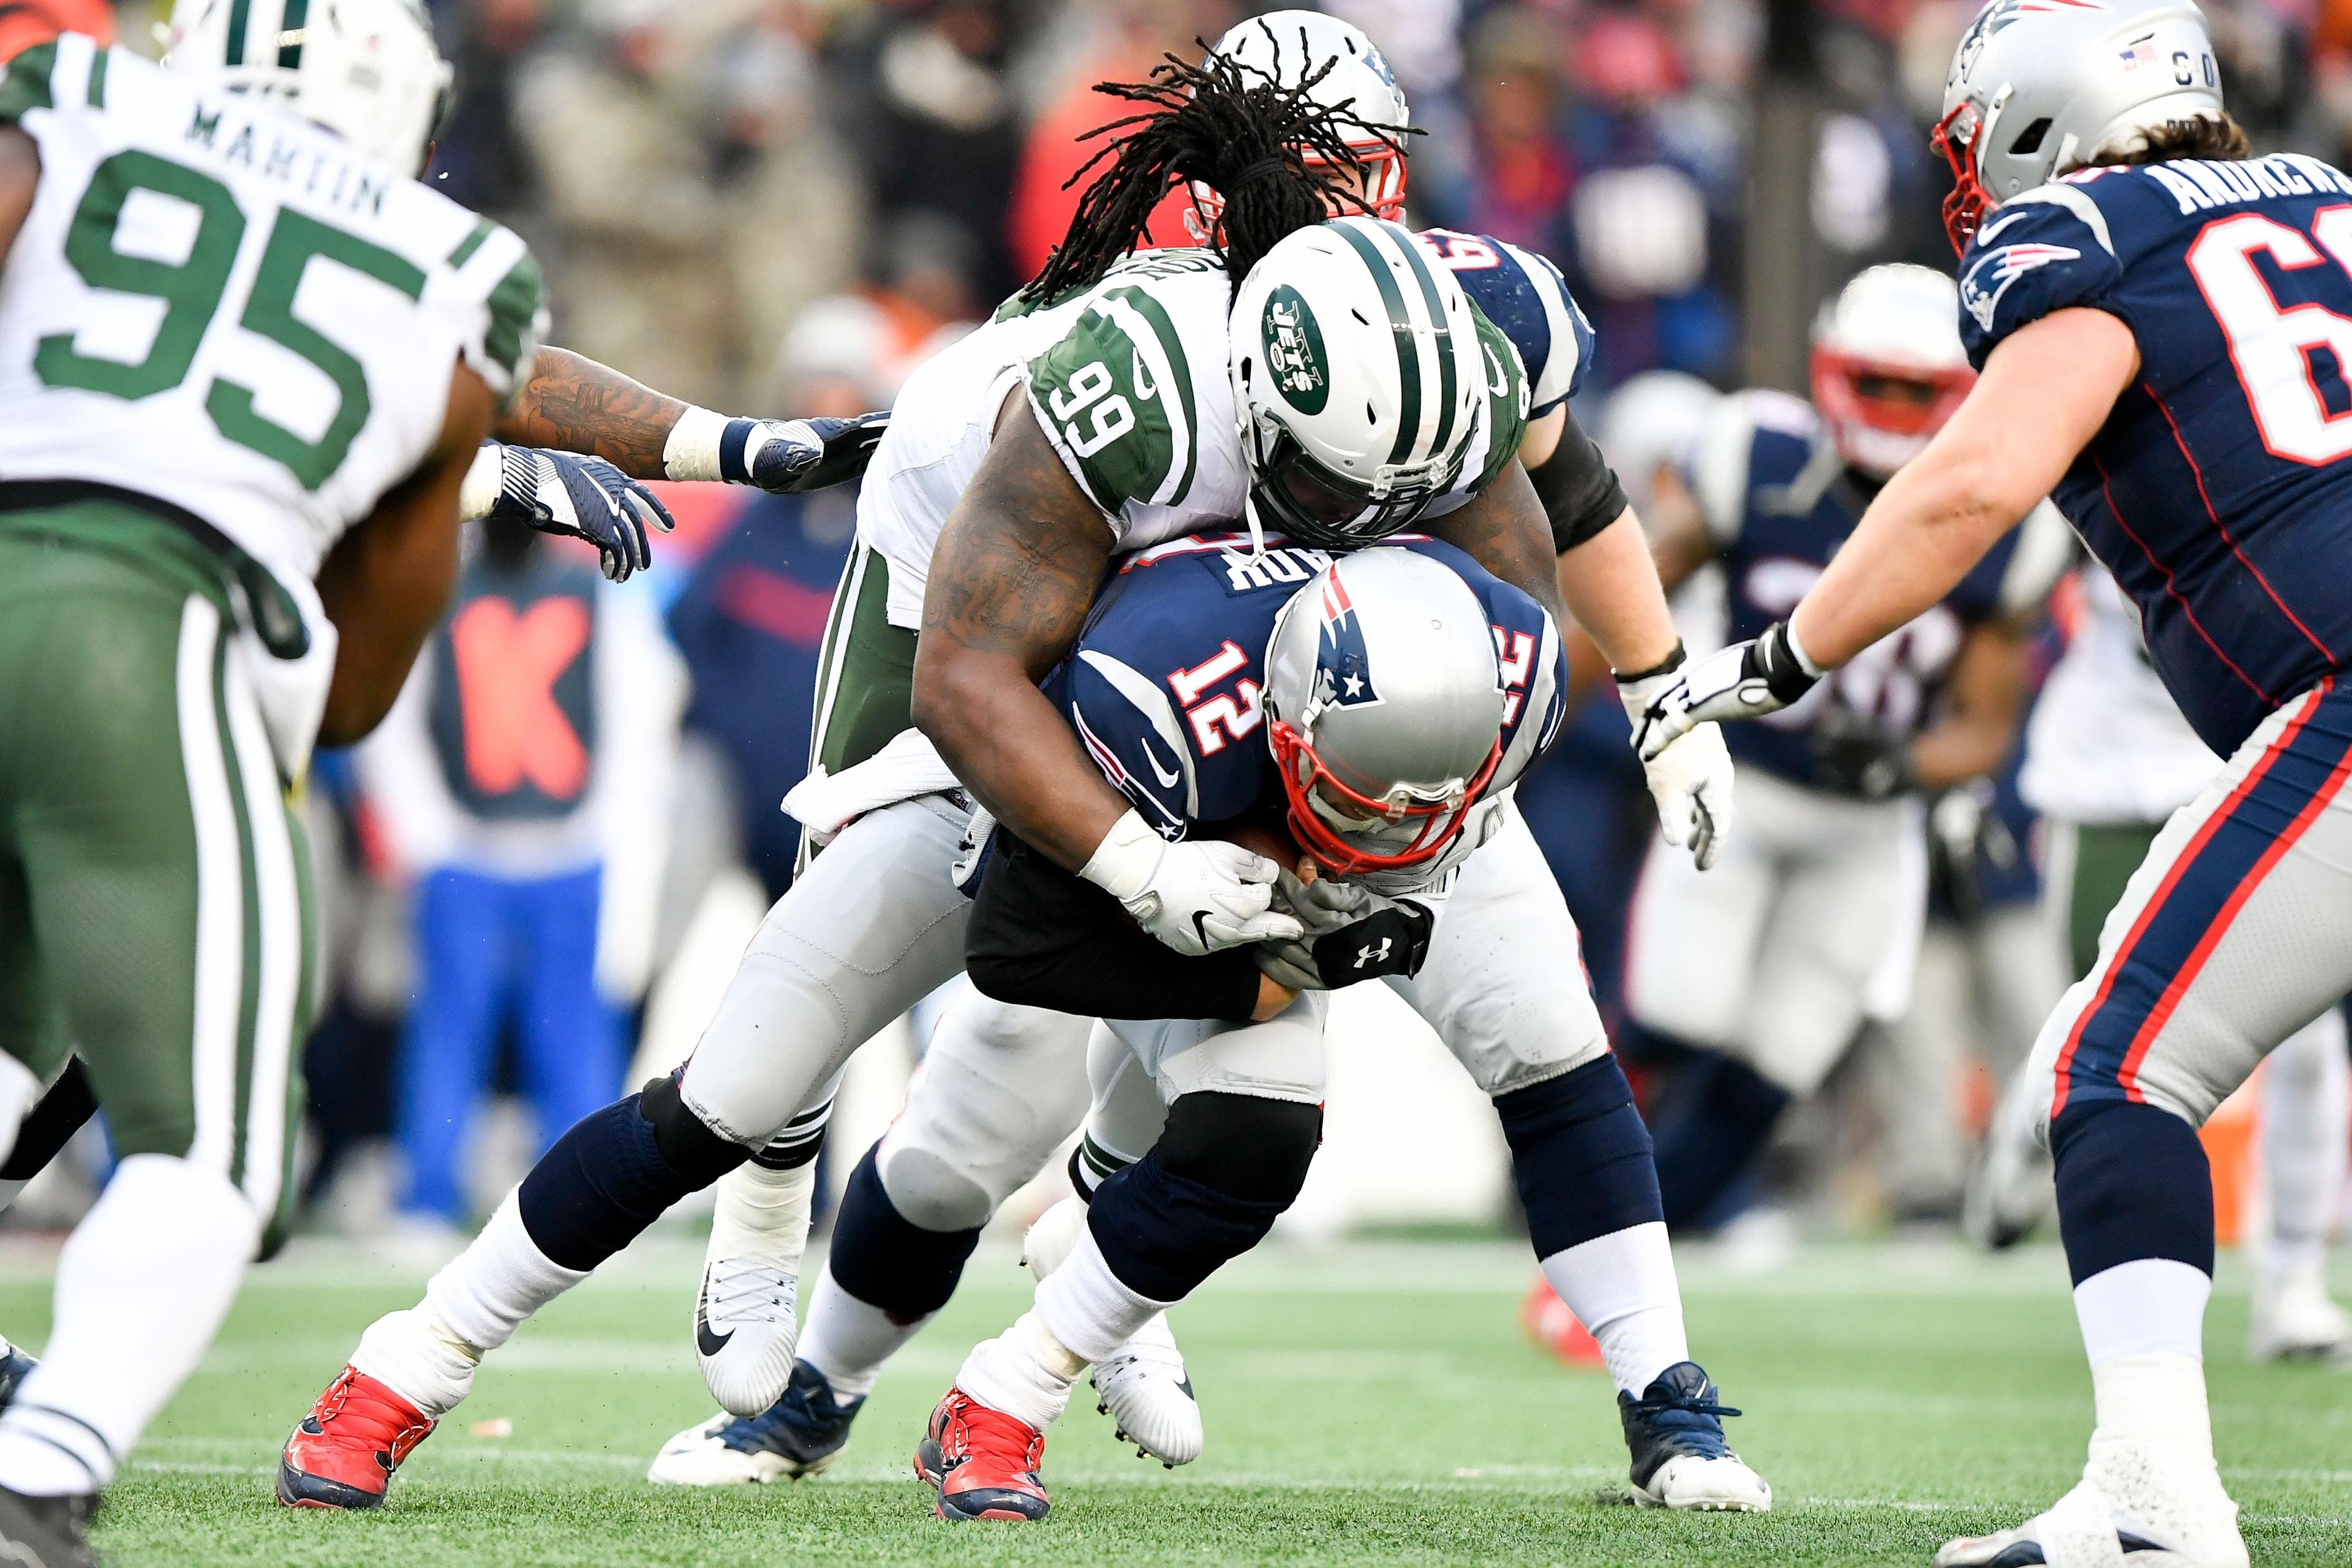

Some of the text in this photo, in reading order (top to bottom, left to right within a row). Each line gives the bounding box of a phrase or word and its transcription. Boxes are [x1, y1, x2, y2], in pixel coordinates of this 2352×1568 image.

[184, 102, 392, 217] MARTIN
[32, 148, 427, 492] 95
[1272, 301, 1313, 392] JETS
[2184, 203, 2352, 468] 6
[1048, 360, 1136, 459] 99
[451, 594, 592, 802] K
[1166, 639, 1265, 758] 12
